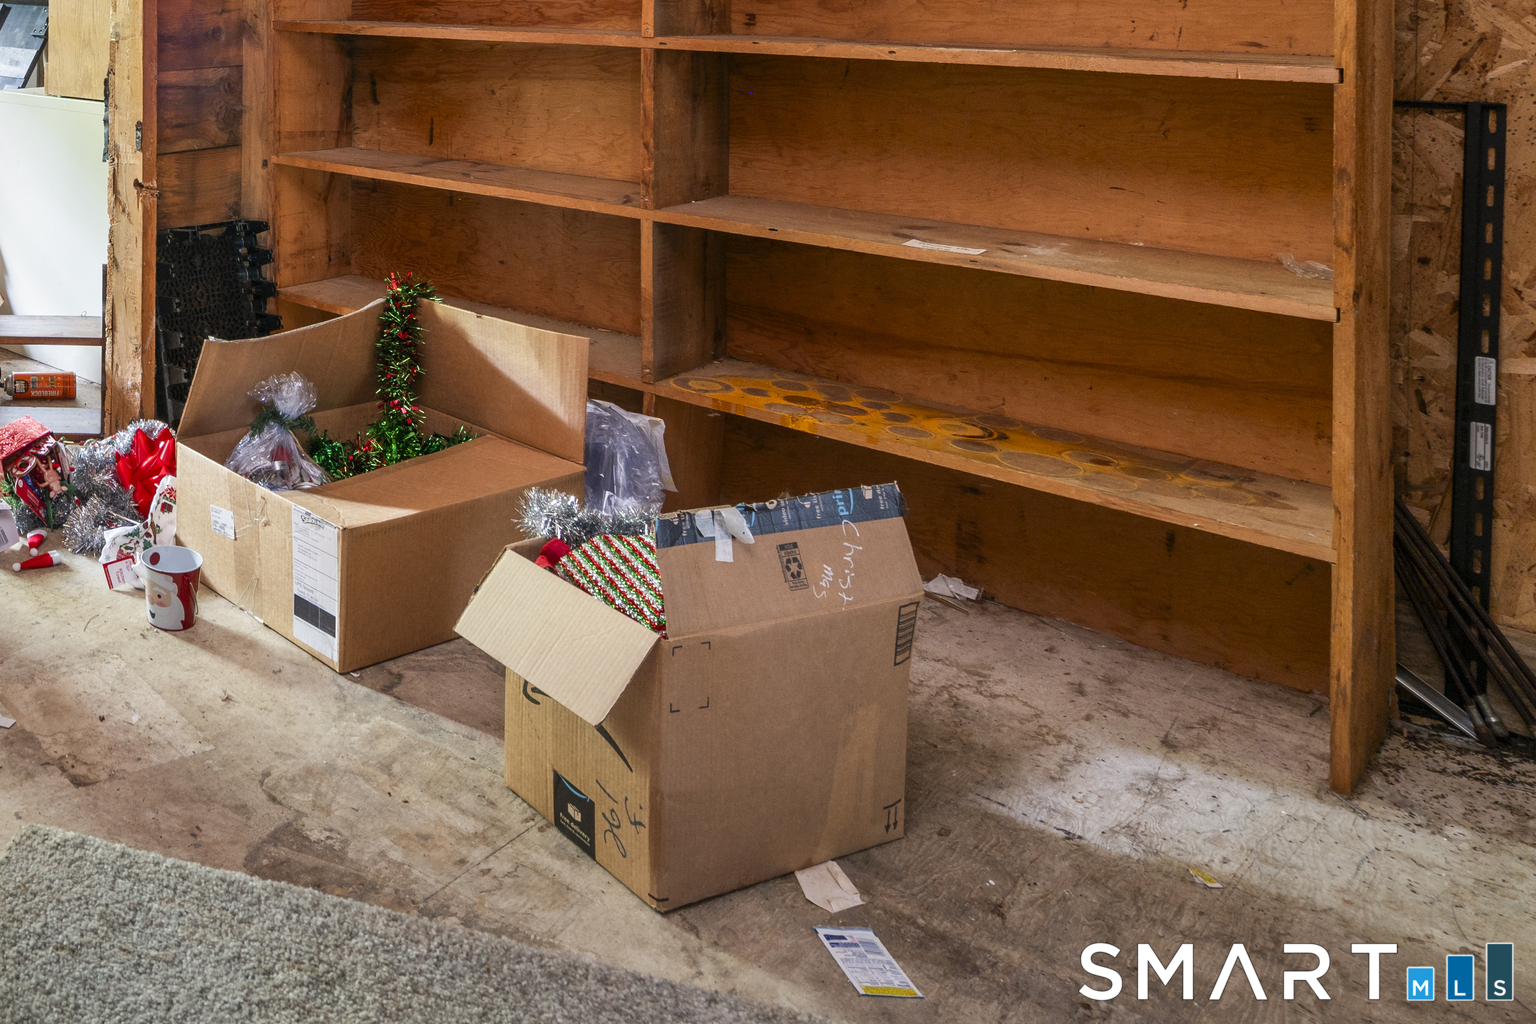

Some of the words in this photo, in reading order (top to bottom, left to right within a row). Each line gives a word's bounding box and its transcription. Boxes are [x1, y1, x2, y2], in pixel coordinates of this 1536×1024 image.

[832, 488, 849, 517] pri
[559, 812, 571, 826] free
[570, 822, 590, 843] delivery
